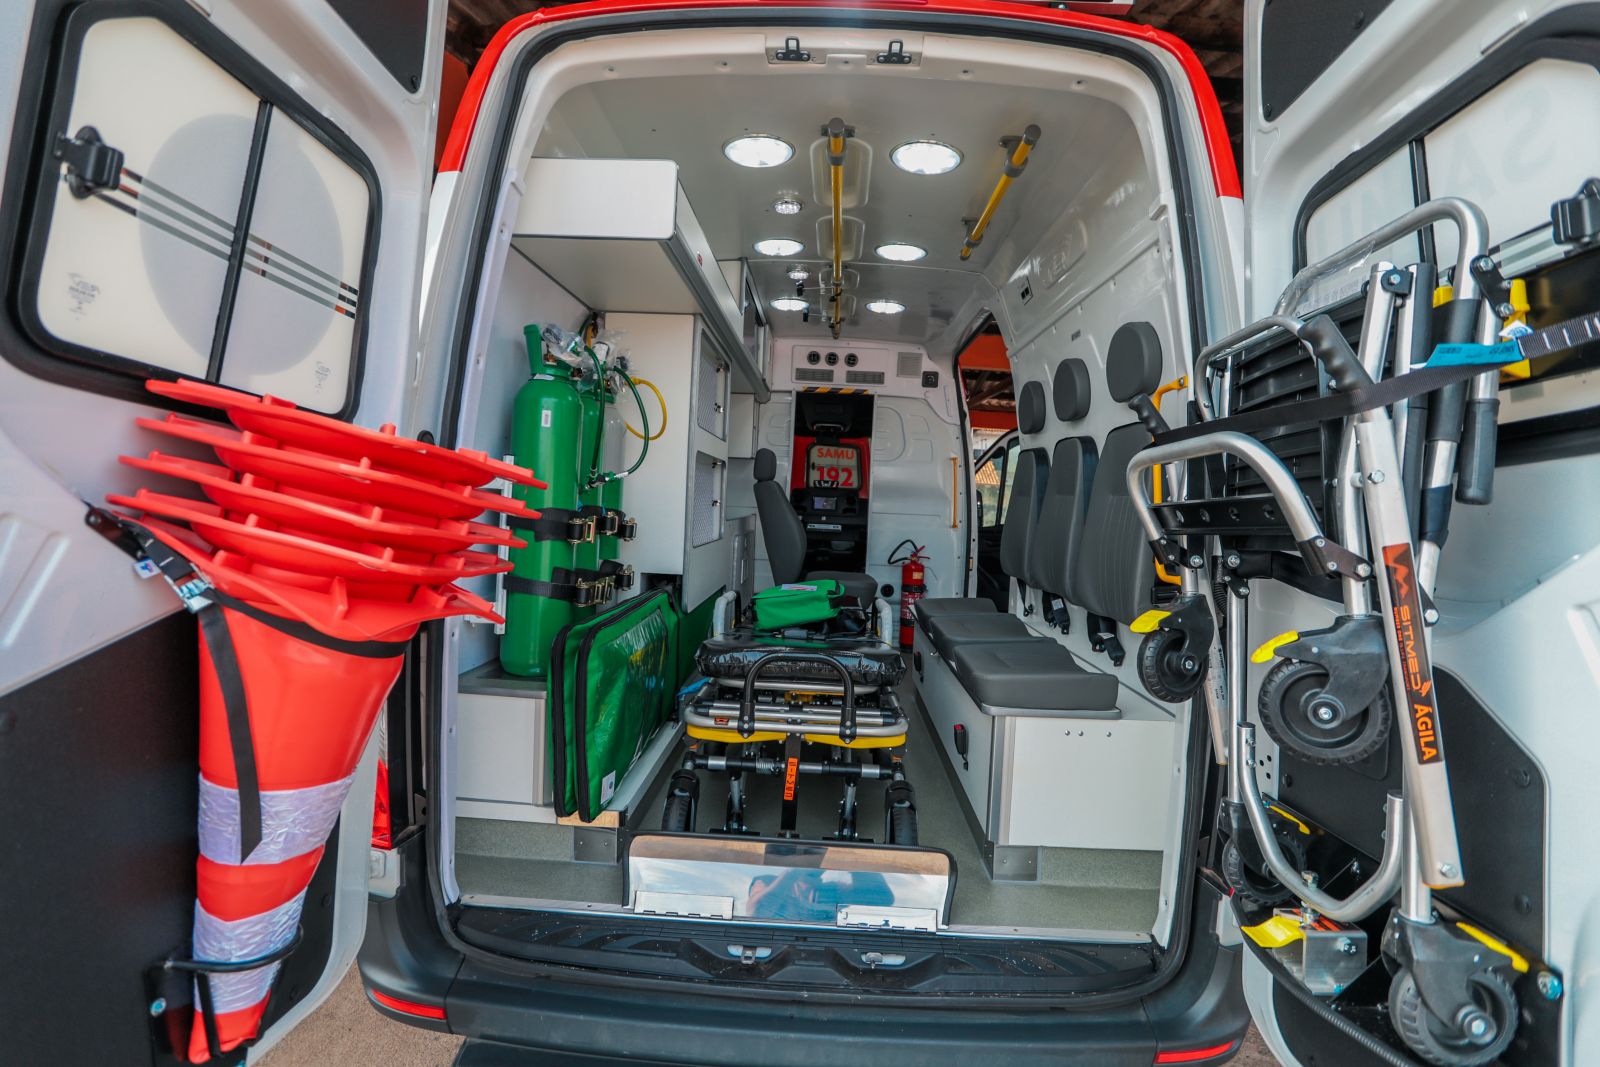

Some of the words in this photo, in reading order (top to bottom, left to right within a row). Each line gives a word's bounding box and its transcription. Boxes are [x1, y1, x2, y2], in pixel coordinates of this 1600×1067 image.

[817, 448, 855, 460] SAMU
[816, 466, 855, 487] 192
[1400, 604, 1422, 692] SITMED
[1414, 704, 1437, 761] ÁGILA
